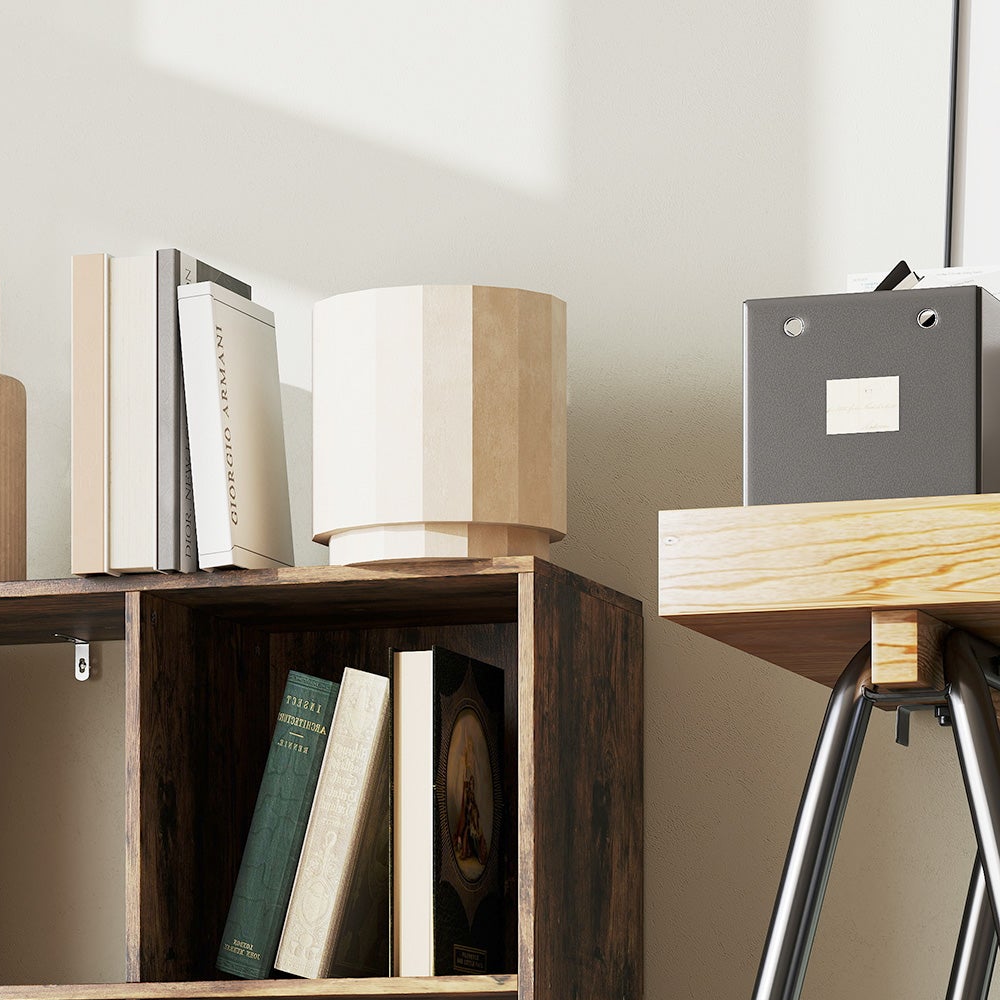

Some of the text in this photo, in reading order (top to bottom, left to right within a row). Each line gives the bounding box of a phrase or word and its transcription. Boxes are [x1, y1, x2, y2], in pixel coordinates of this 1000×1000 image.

[215, 324, 238, 526] GIORGIO ARMANI
[184, 508, 192, 559] DIOR.
